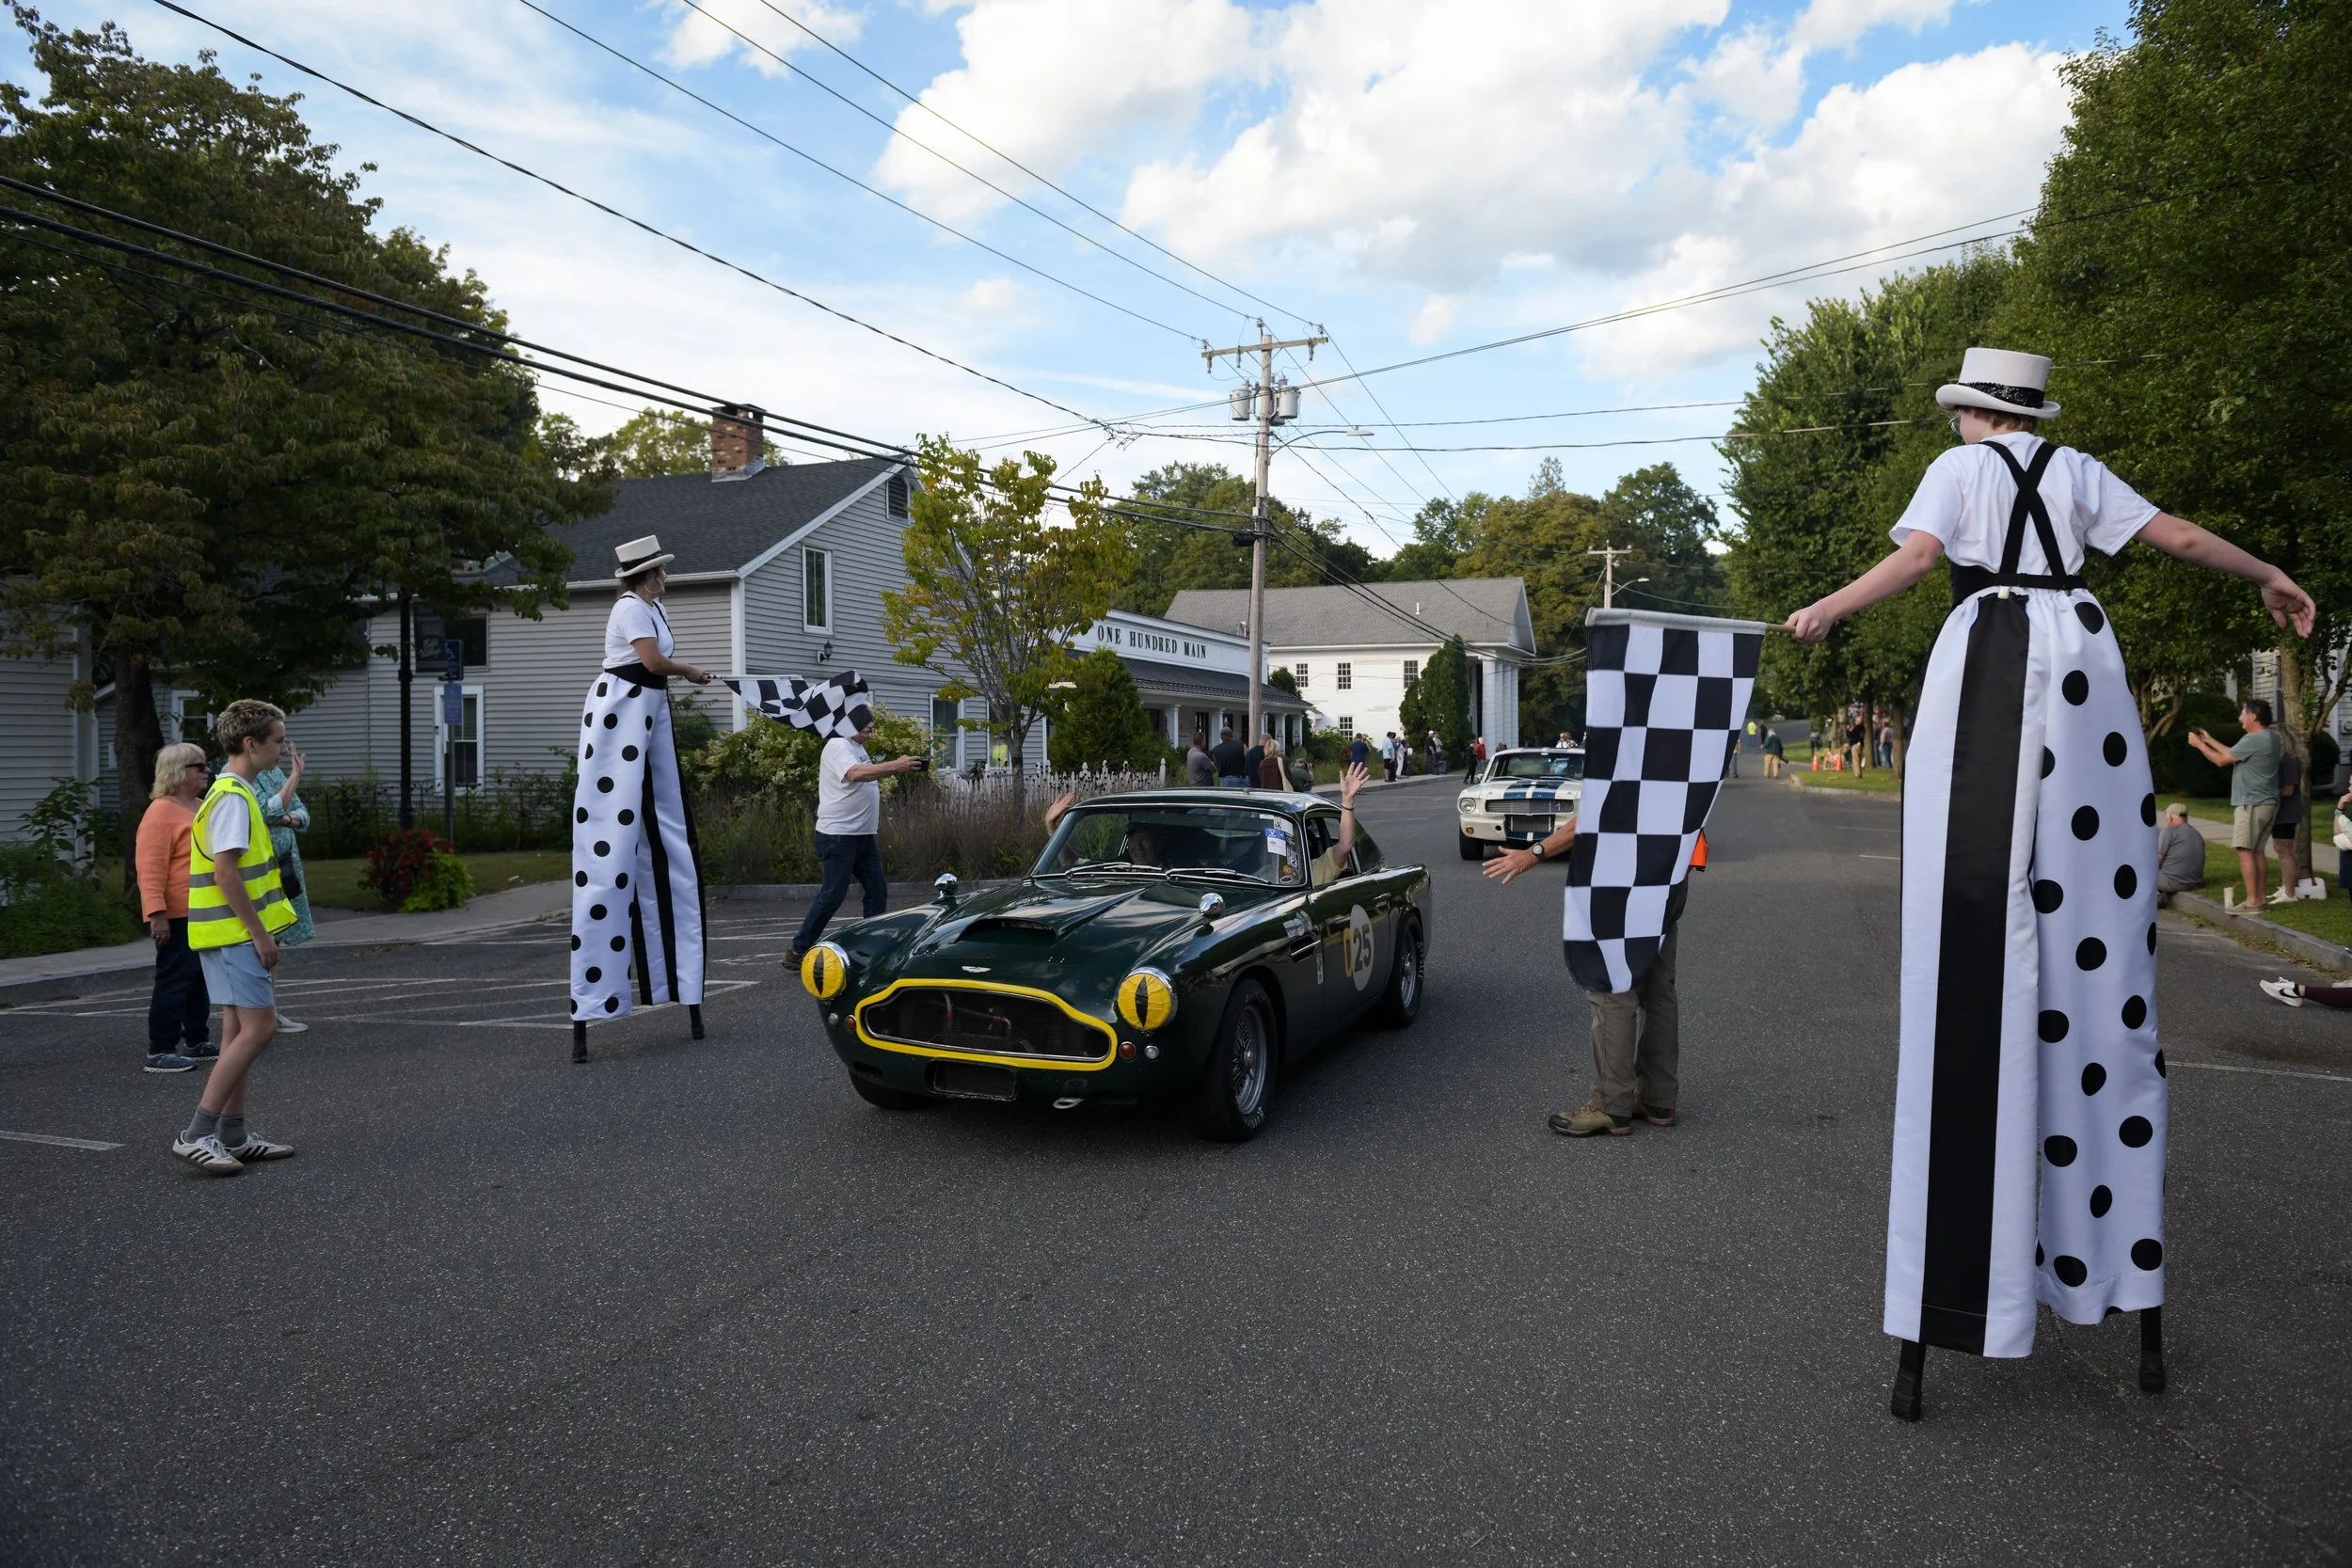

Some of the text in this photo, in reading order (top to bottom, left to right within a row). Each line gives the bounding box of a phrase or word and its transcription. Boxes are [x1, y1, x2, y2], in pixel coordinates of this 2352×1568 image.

[1097, 625, 1206, 658] ONE HUNDRED MAIN
[1353, 922, 1372, 973] 25
